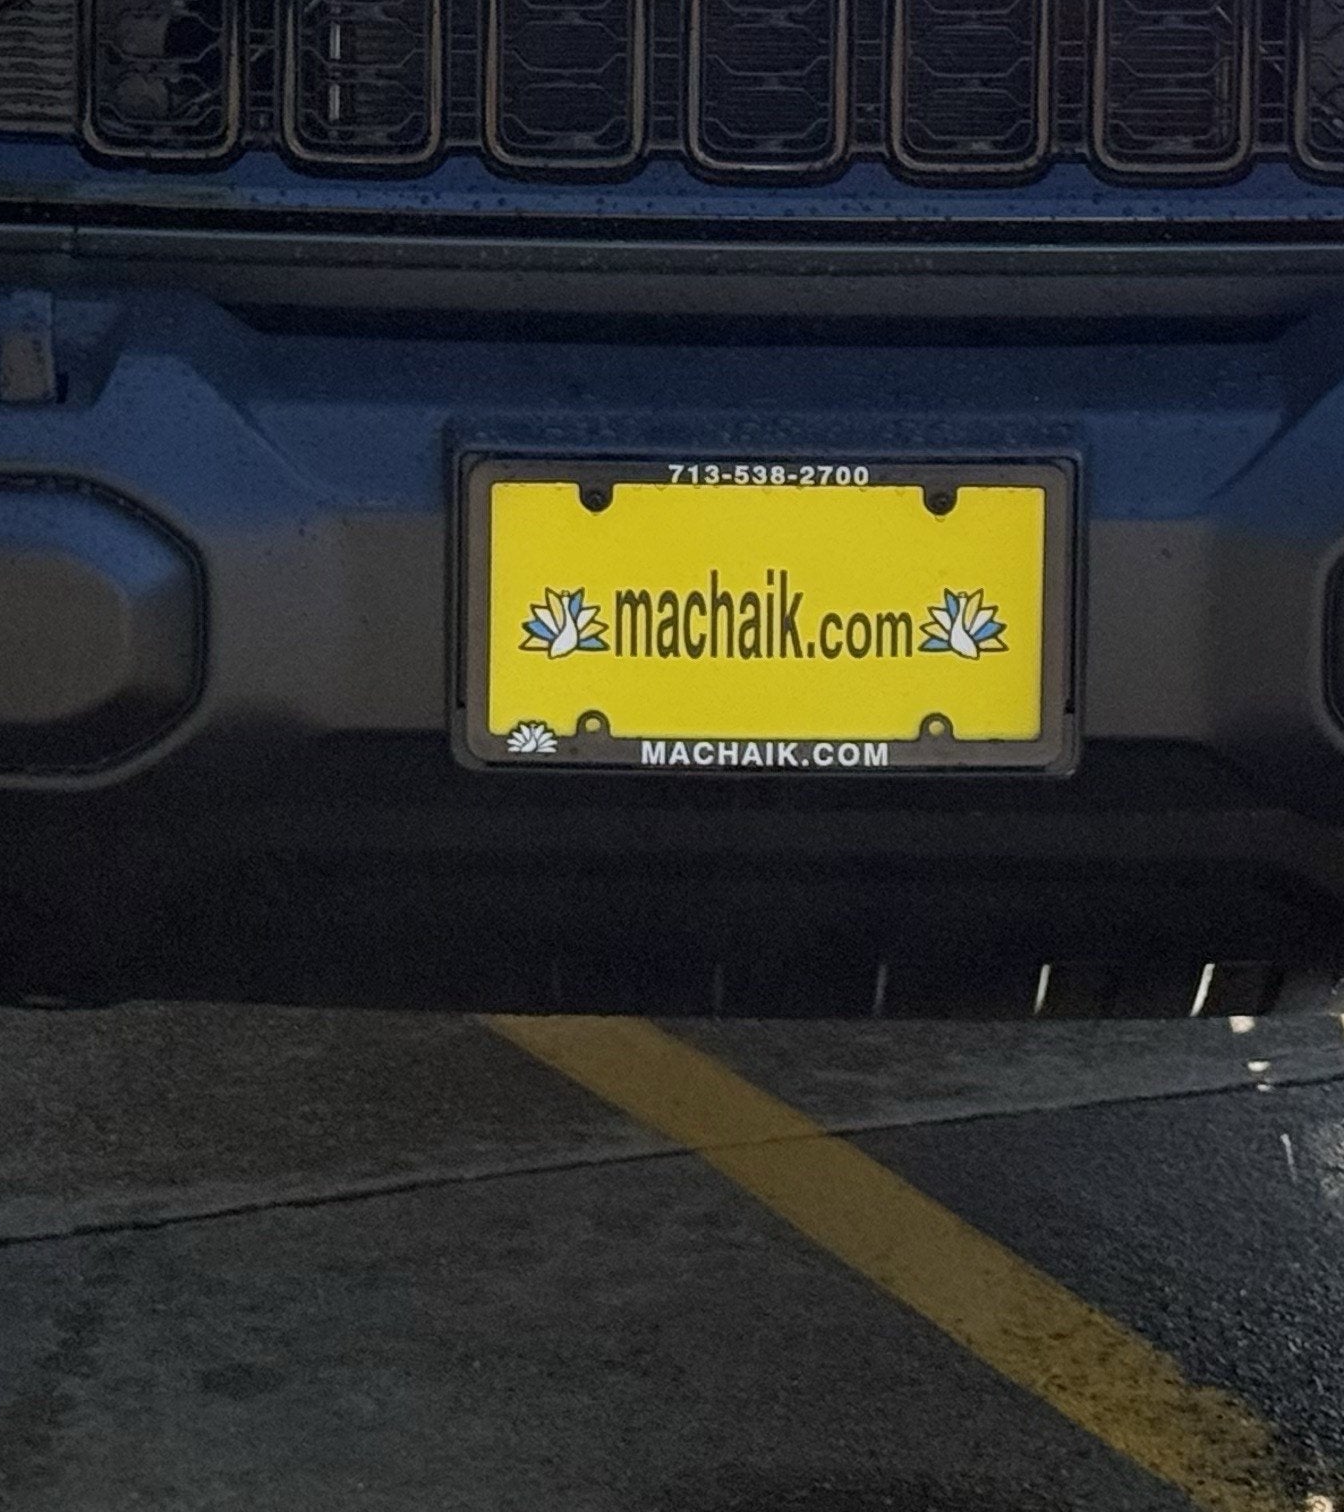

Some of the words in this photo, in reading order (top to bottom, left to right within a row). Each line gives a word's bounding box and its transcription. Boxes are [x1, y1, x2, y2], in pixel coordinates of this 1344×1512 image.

[668, 463, 870, 487] 713-538-2700
[615, 569, 913, 659] machaik.com
[640, 740, 890, 768] MACHAIK.COM
